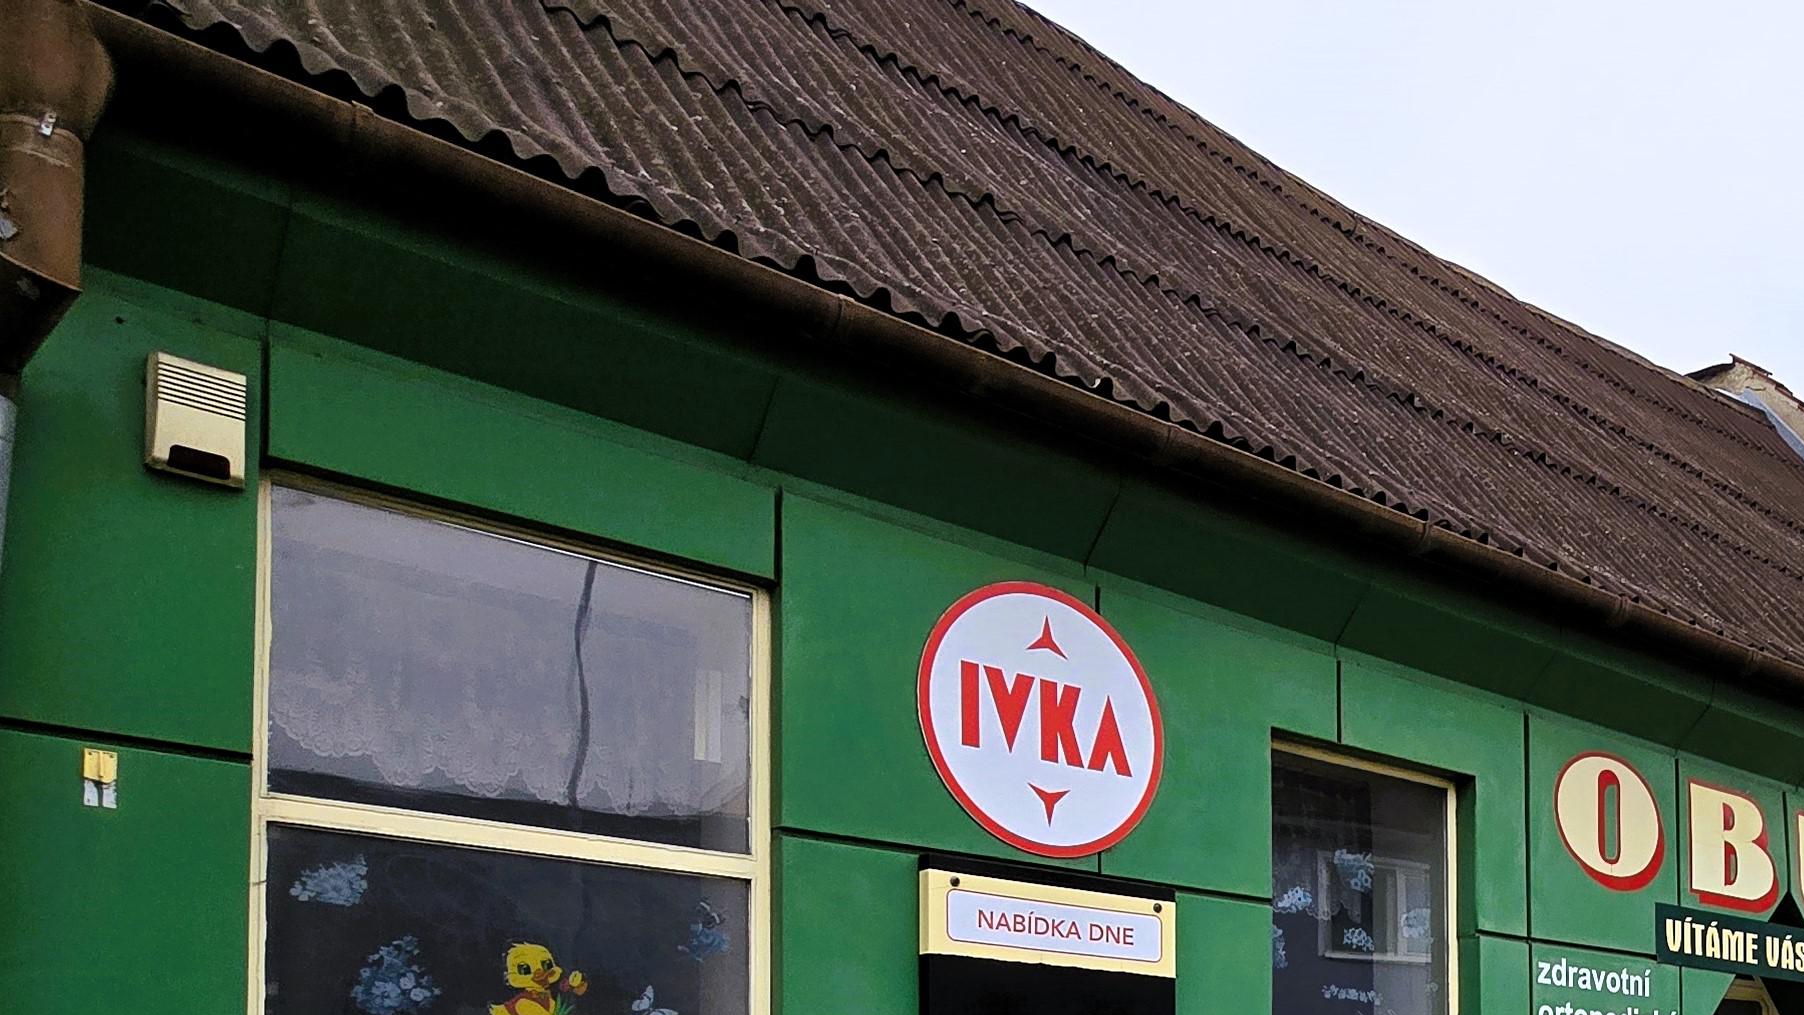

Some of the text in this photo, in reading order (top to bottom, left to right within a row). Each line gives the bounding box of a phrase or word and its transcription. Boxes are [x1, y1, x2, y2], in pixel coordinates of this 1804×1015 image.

[960, 659, 1133, 778] IVKA
[977, 909, 1135, 946] NABÍDKA DNE
[1665, 916, 1759, 965] VÍTÁME
[1537, 957, 1651, 998] zdravotní
